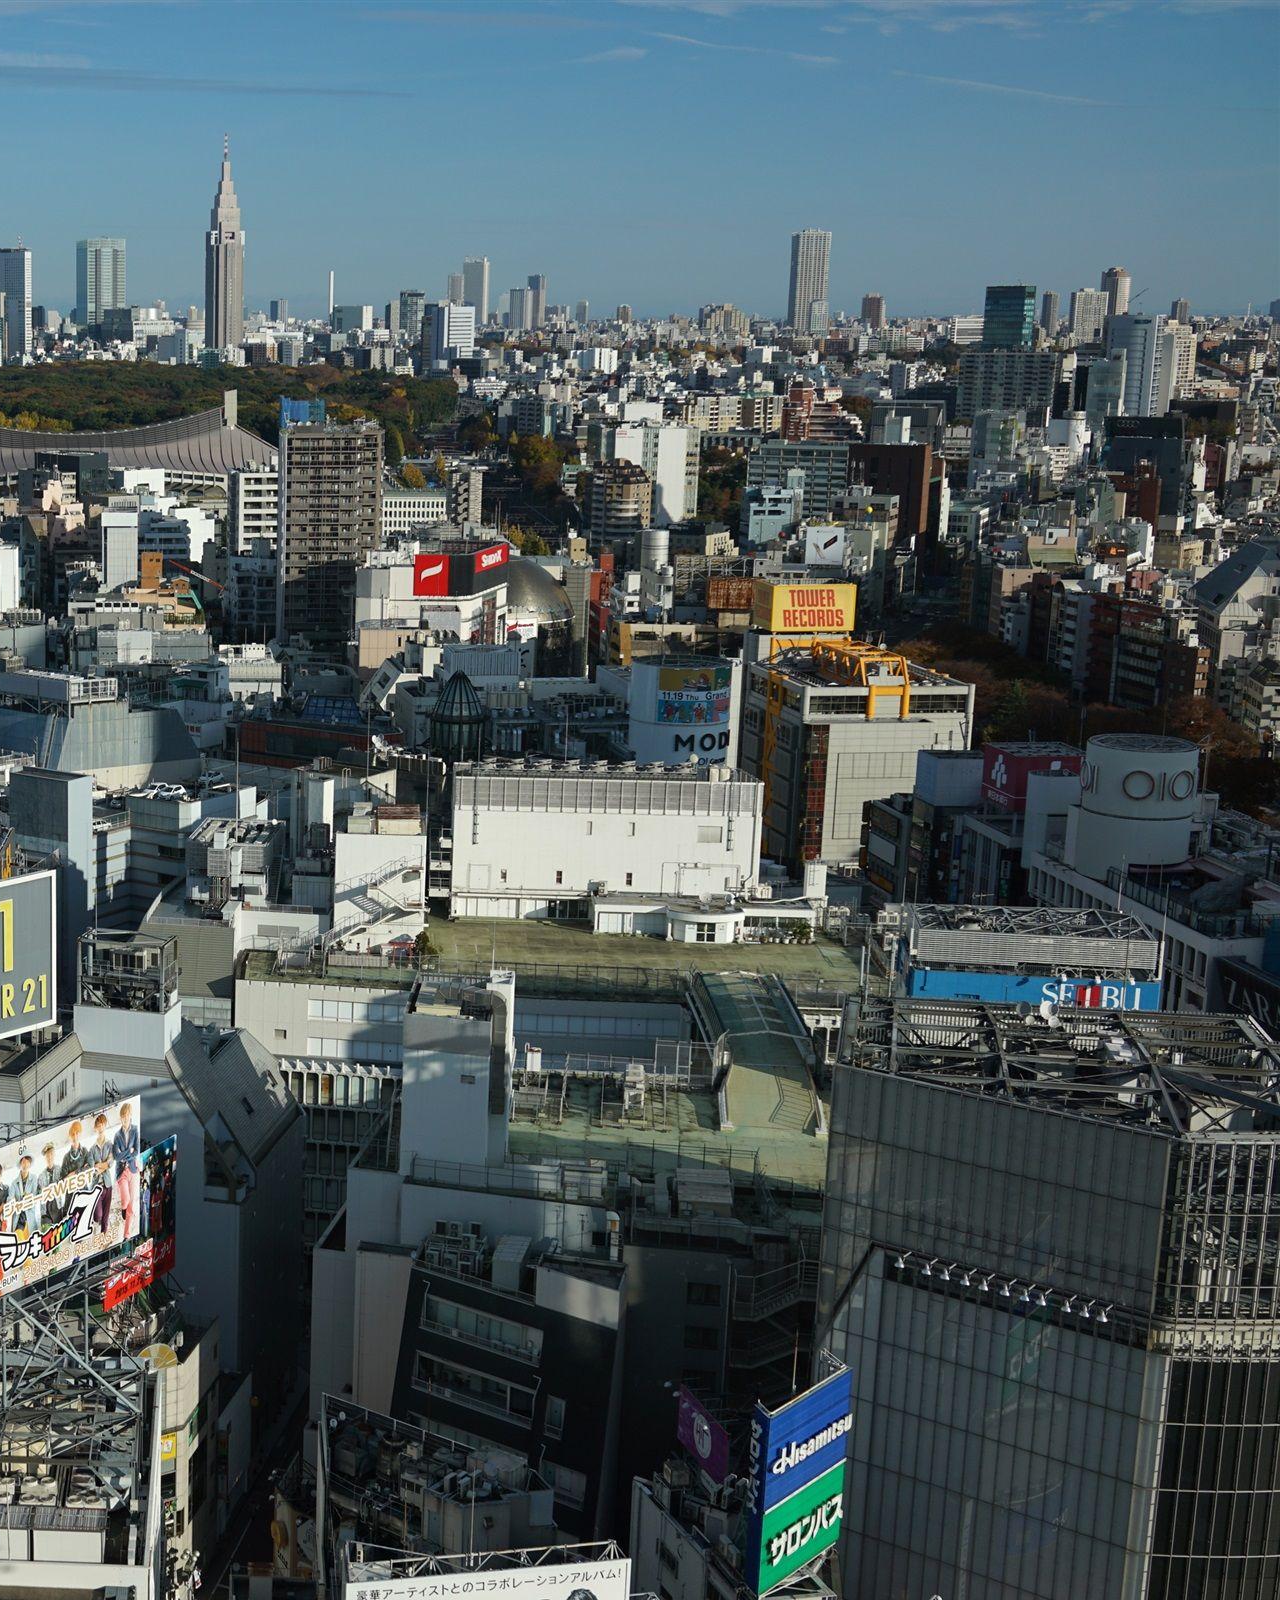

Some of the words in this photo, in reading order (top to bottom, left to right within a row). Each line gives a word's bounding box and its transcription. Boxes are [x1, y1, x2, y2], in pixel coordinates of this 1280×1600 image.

[789, 589, 836, 607] TOWER
[783, 609, 844, 627] RECORDS
[22, 974, 47, 1014] 21
[1042, 981, 1141, 1010] SEIBU
[772, 1413, 853, 1475] Hisamitsu
[770, 1493, 843, 1567] サロンパス
[356, 1567, 622, 1600] 豪華アーティストとのコラボレーションアルバム!
